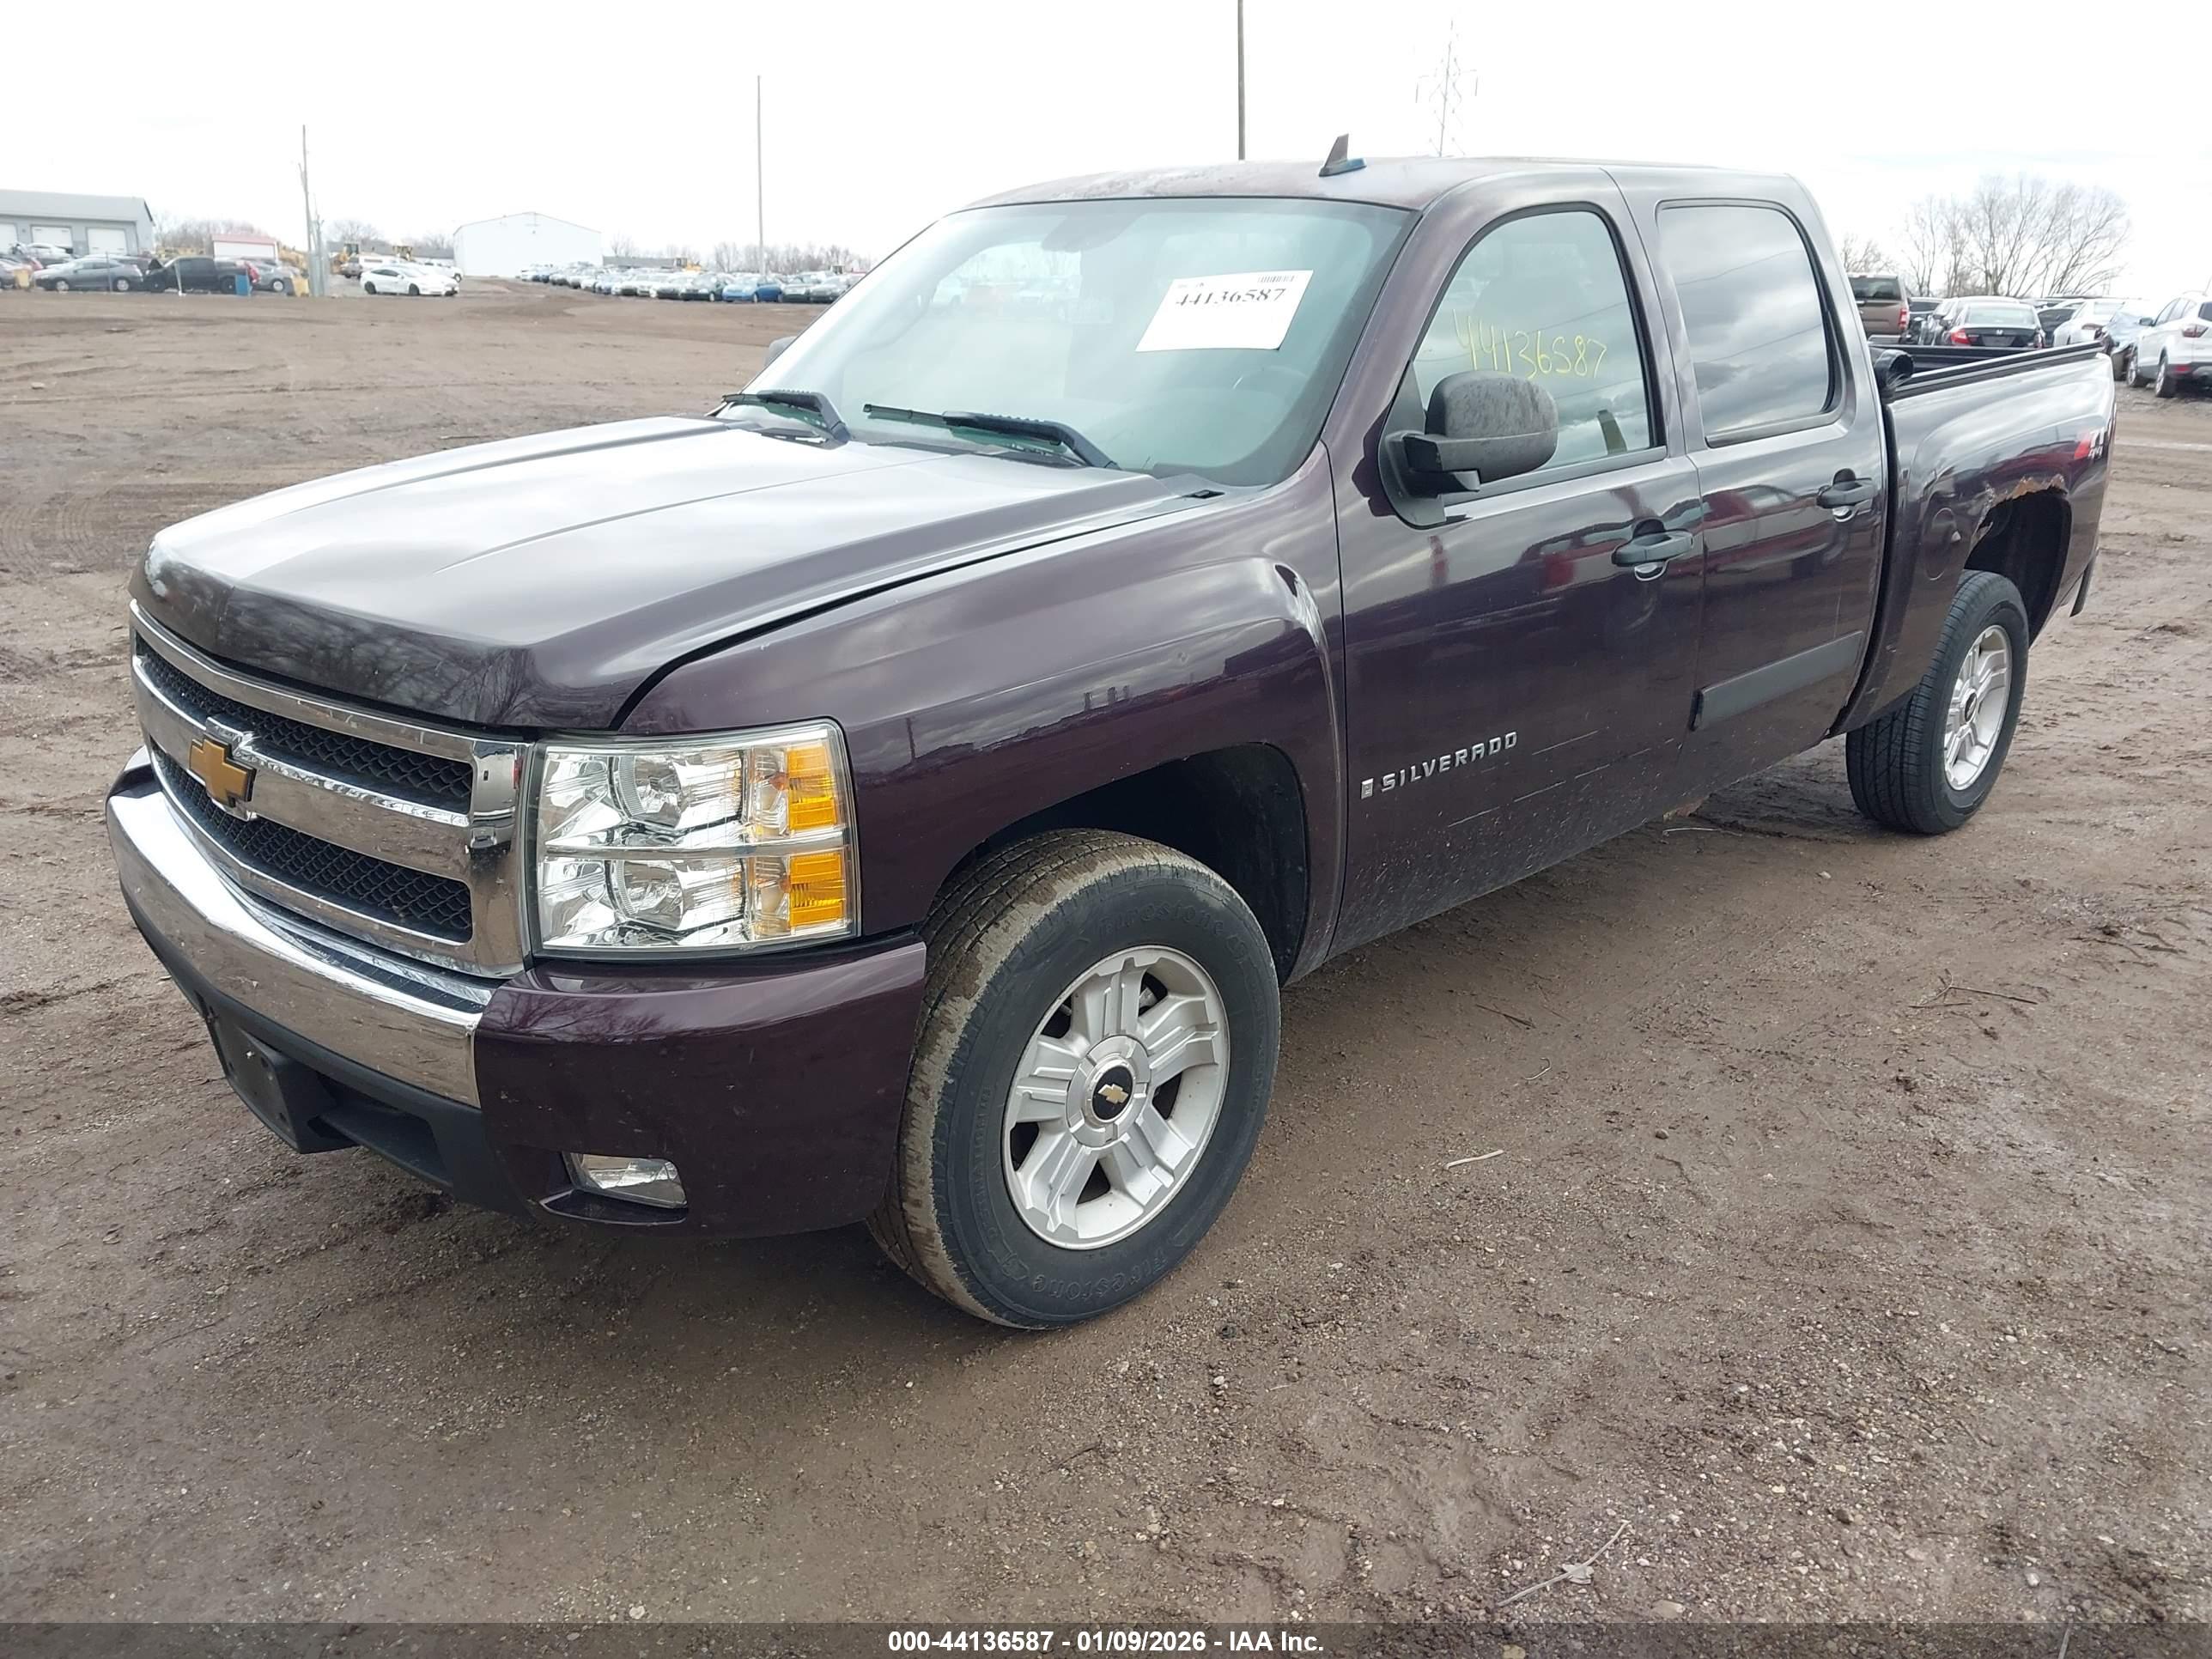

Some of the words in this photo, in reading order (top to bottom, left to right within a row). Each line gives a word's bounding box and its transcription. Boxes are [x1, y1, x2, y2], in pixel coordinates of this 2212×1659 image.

[1176, 288, 1286, 307] 44136587
[1453, 309, 1607, 380] 44136587
[1381, 732, 1518, 793] SILVERADO
